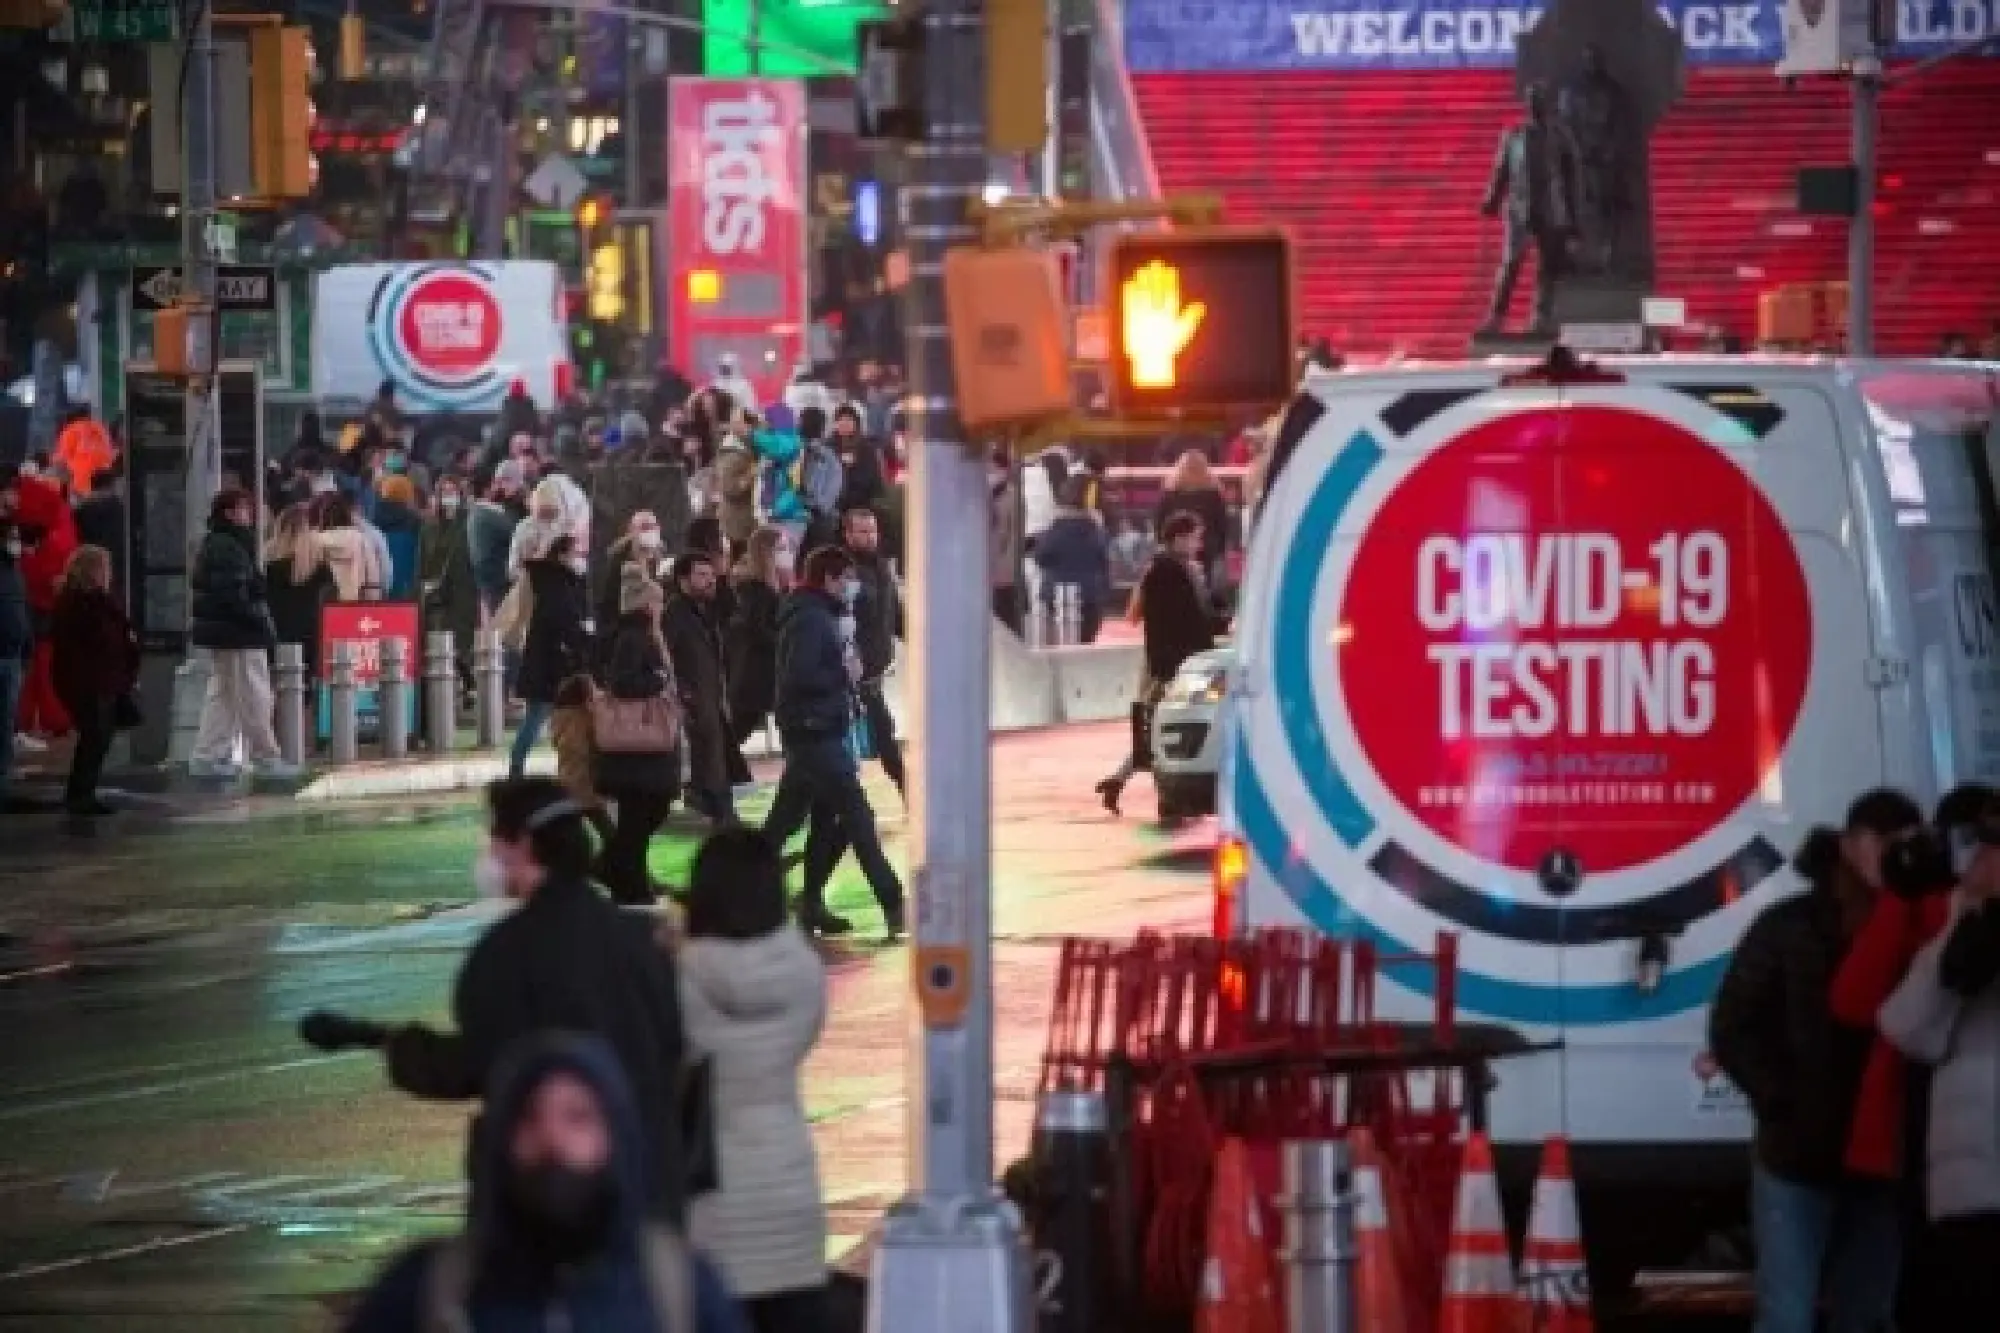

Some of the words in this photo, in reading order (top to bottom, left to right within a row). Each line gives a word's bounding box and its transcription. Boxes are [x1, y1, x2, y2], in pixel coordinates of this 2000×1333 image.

[1291, 9, 1546, 55] WELCOM
[1417, 530, 1729, 630] COVID-19
[1426, 638, 1717, 739] TESTING
